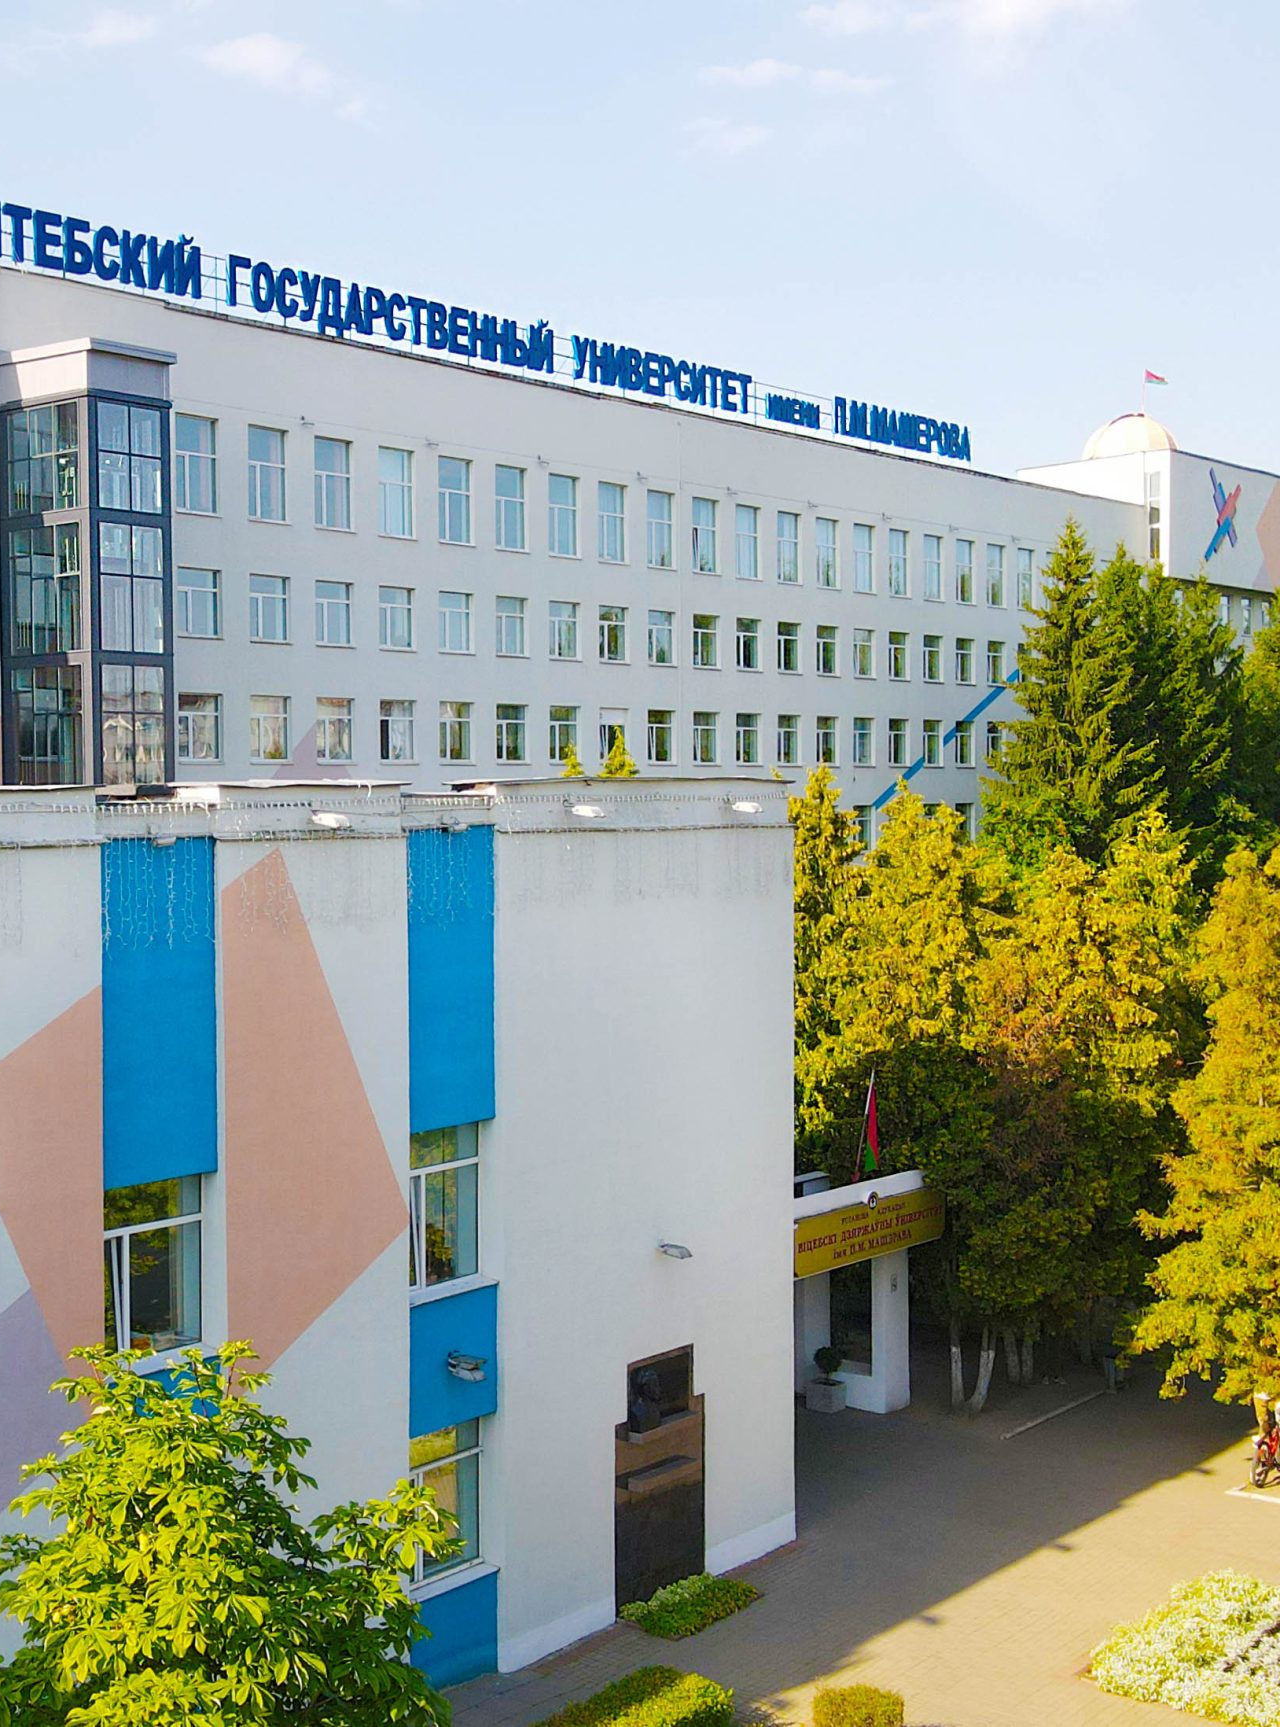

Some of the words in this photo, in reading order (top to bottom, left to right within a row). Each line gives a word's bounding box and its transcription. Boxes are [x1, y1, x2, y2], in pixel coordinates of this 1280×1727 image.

[225, 255, 554, 374] ГОСУДАРСТВЕННЫЙ
[571, 334, 752, 414] УНИВЕРСИТЕТ
[765, 392, 820, 430] ИМЕНИ
